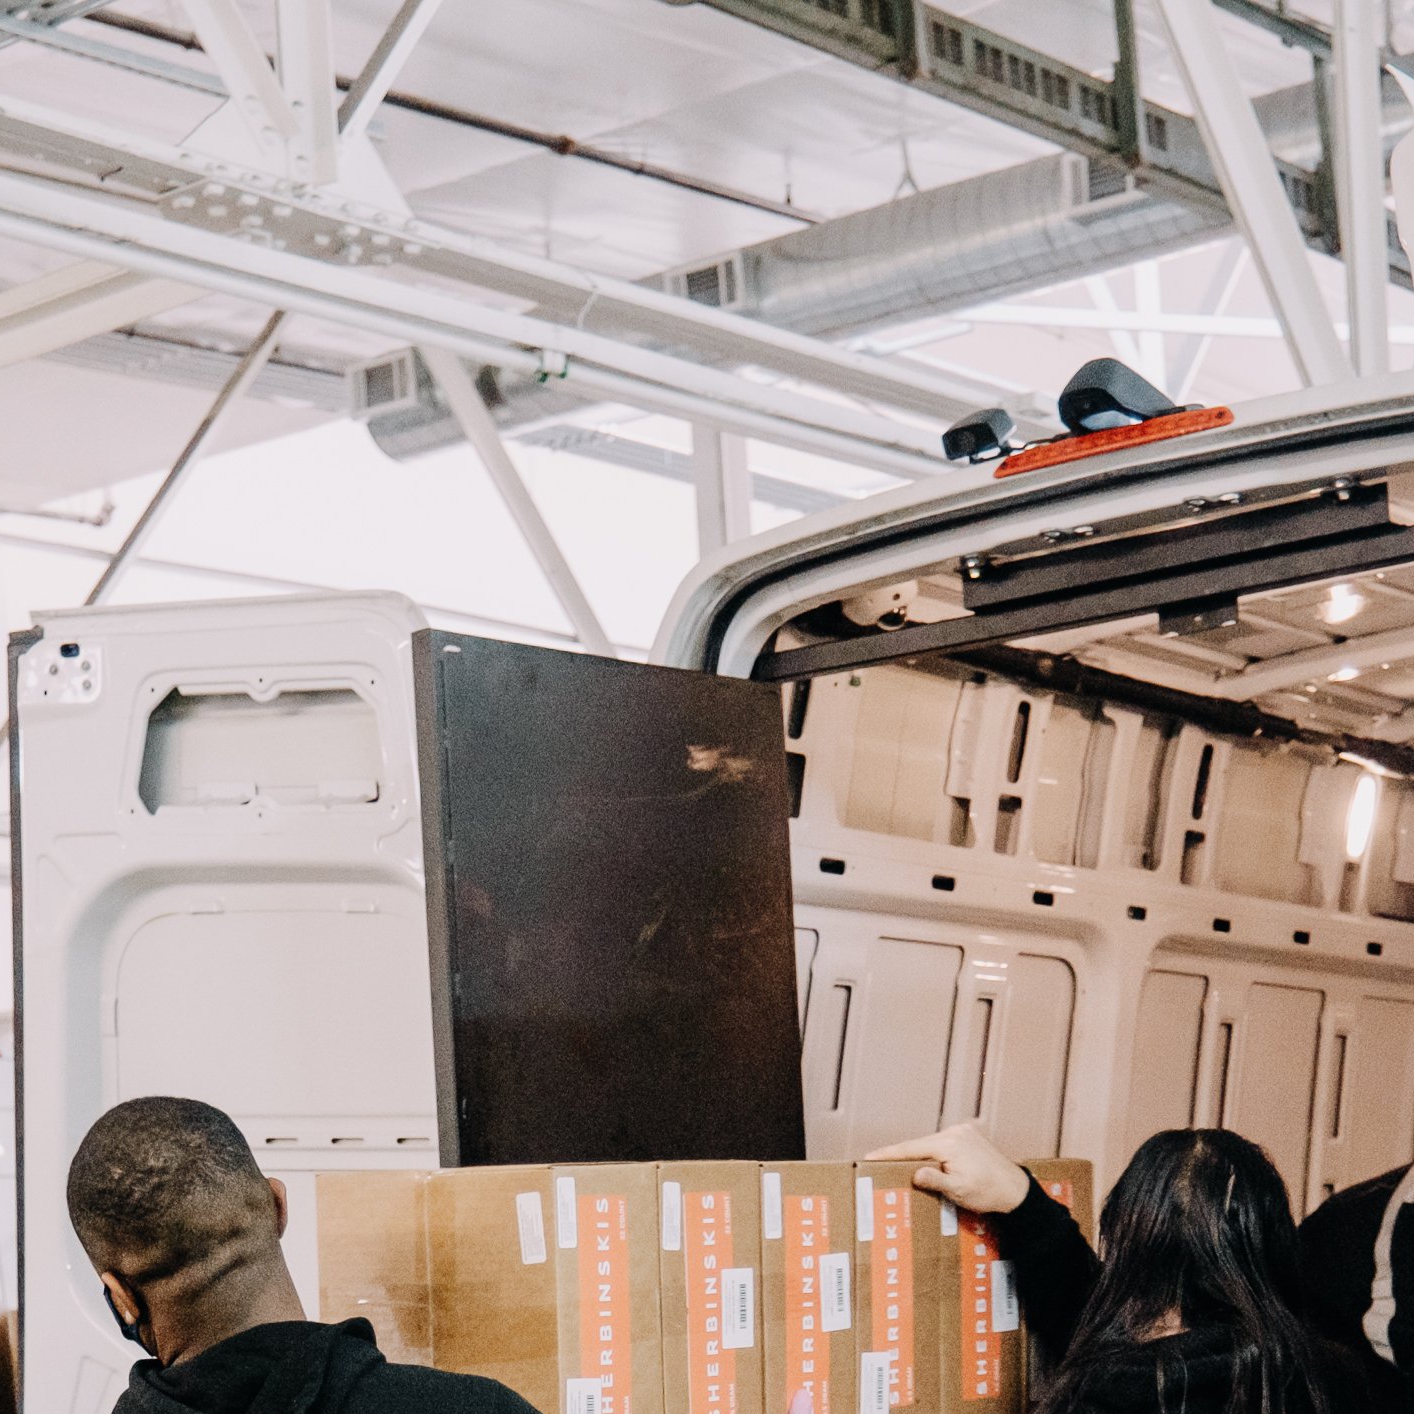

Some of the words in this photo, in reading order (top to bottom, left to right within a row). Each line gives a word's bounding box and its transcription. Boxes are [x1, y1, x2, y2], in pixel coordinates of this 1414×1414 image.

[618, 1200, 626, 1228] COUNT
[884, 1191, 900, 1406] SHERBINSKIS
[974, 1222, 988, 1396] SHERBINSK
